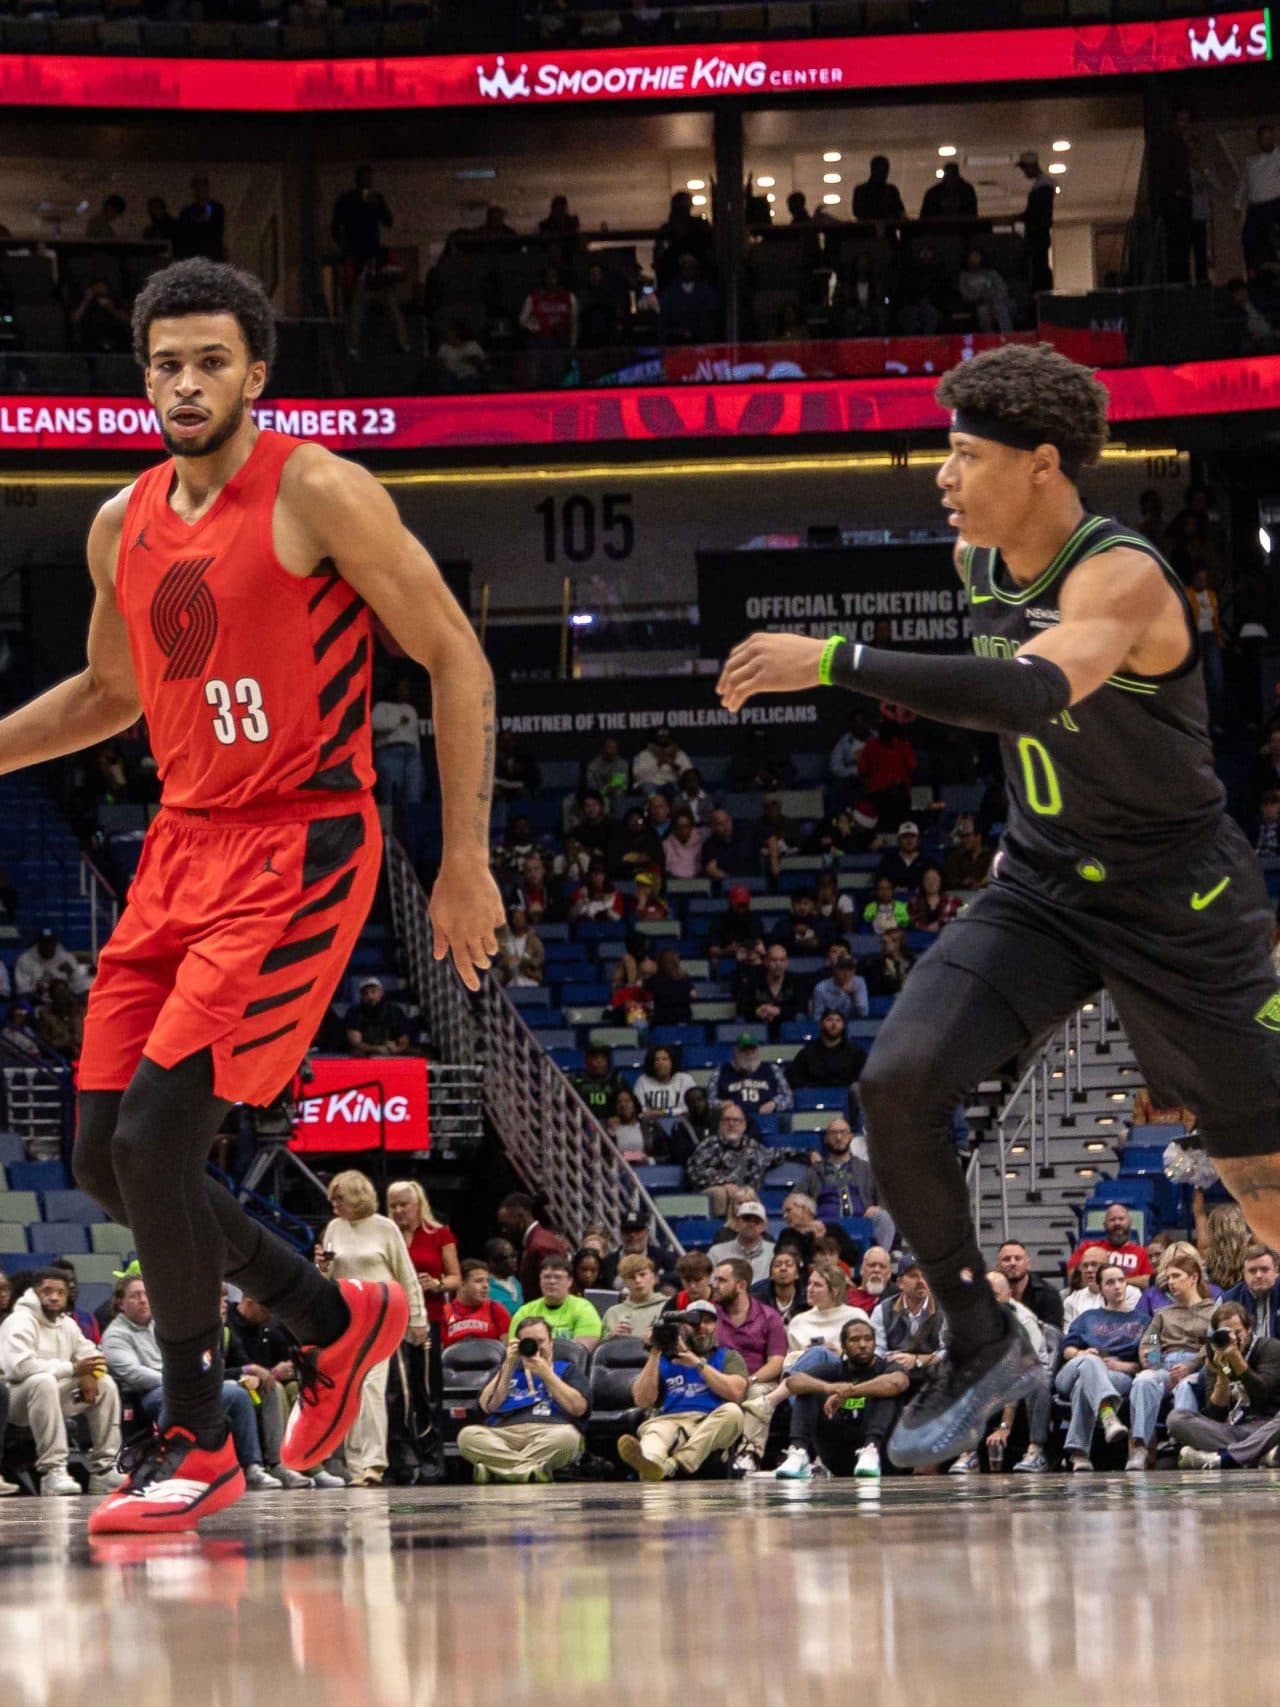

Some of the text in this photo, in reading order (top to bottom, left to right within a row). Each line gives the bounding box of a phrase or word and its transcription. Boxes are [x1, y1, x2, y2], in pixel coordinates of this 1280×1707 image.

[534, 64, 688, 97] SMOOTHIE
[770, 67, 843, 86] CENTER
[98, 407, 163, 434] BOW
[251, 409, 357, 436] EMBER
[362, 407, 396, 435] 23
[1145, 456, 1181, 479] 105
[534, 493, 634, 564] 105
[745, 592, 840, 619] OFFICIAL
[842, 588, 953, 615] TICKETING
[861, 617, 958, 642] OLEANS
[205, 677, 269, 744] 33
[502, 705, 817, 733] PARTNER OF THE NEW ORLEANS PELICANS
[1018, 735, 1063, 815] 0
